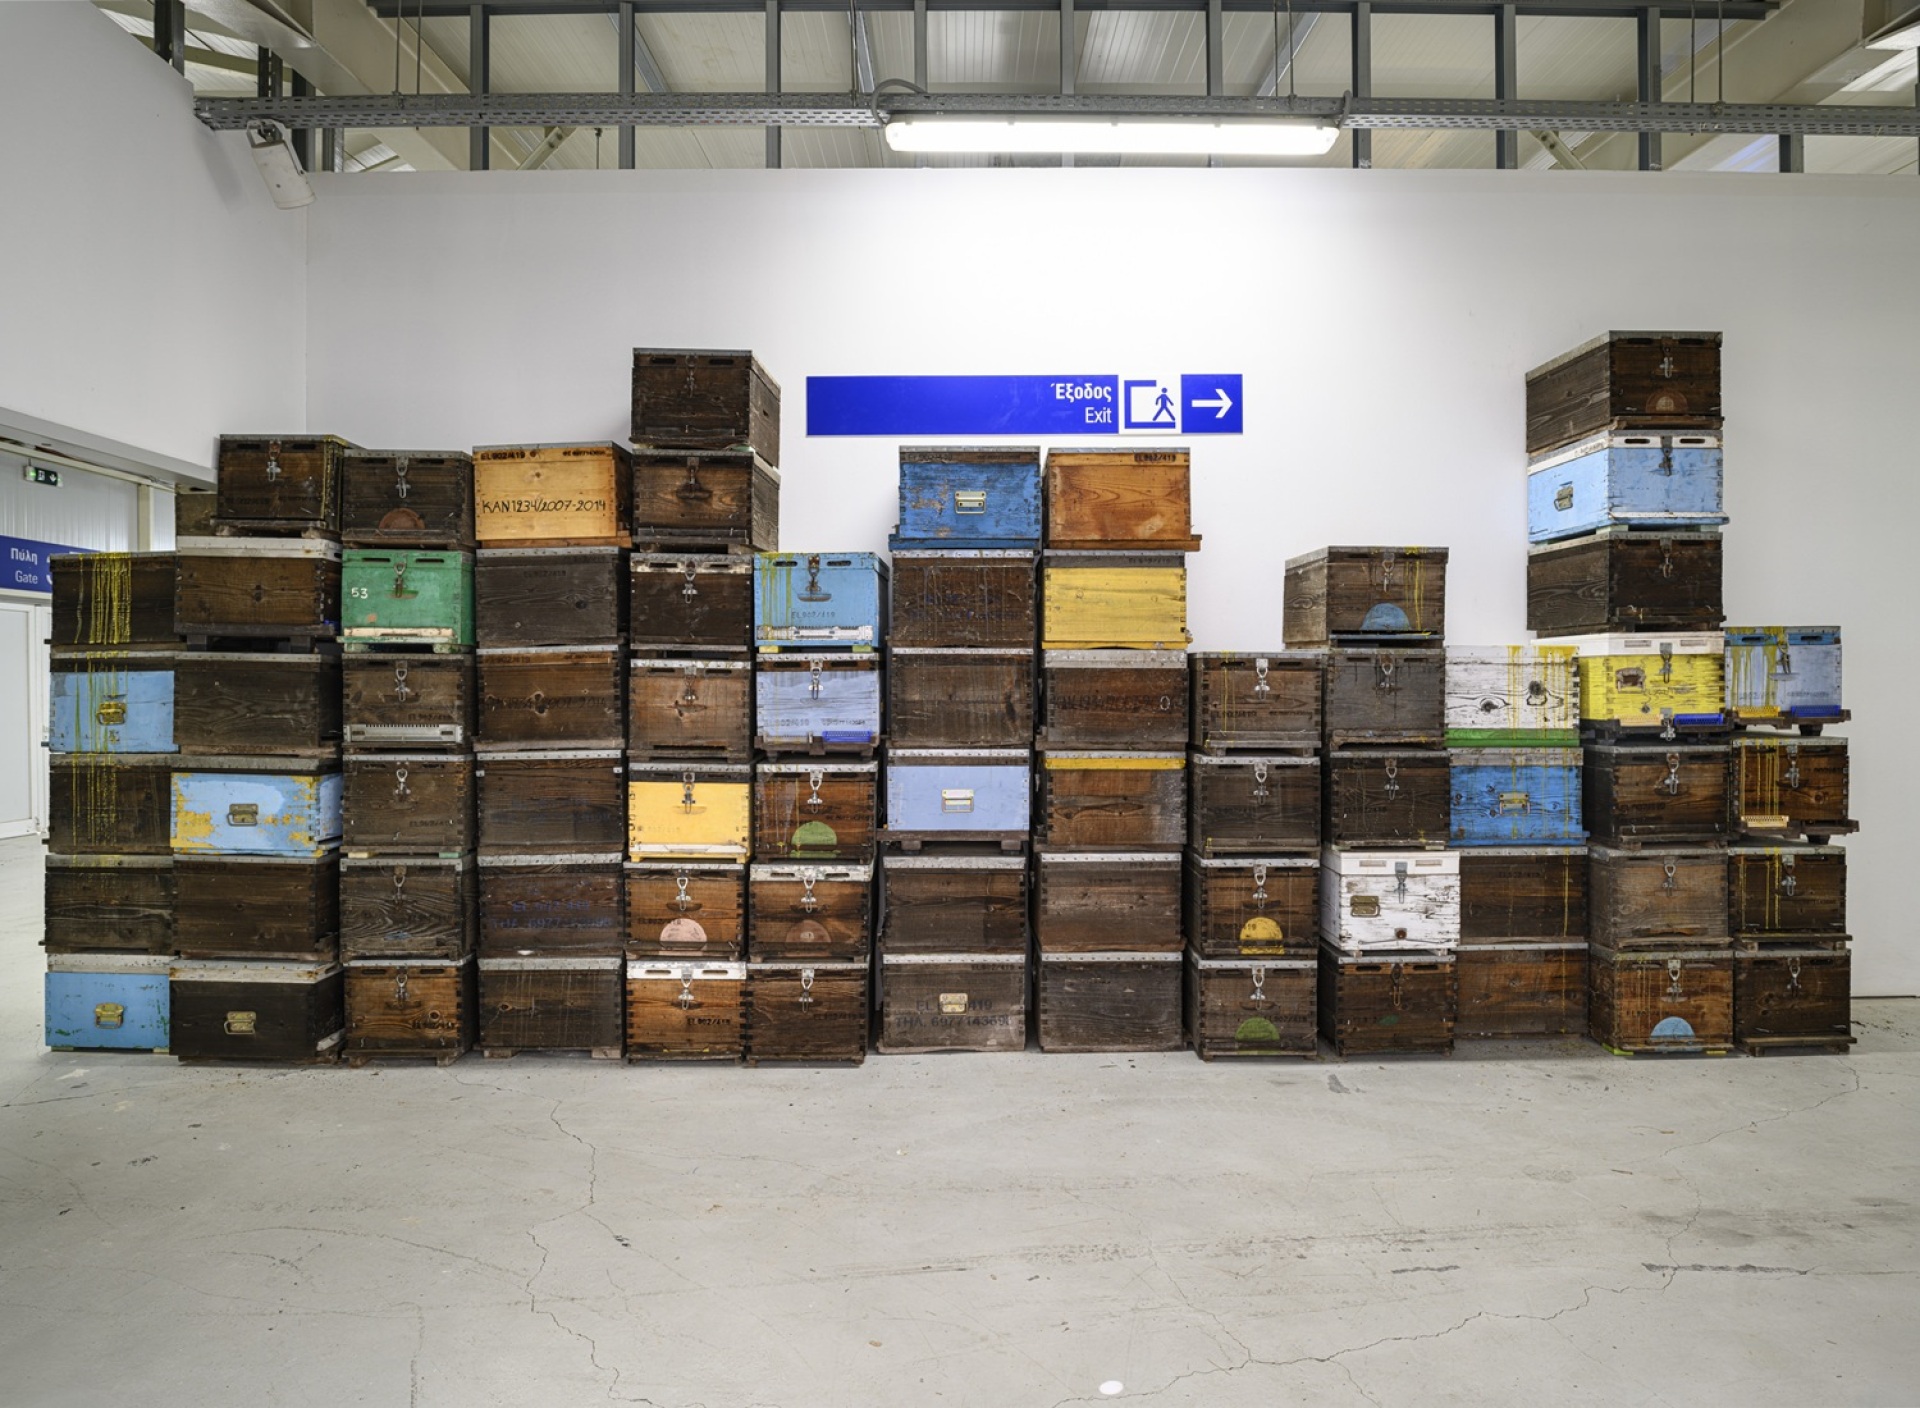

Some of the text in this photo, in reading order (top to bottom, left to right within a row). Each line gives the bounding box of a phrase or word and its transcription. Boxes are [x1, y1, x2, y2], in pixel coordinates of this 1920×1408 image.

[1050, 383, 1112, 403] Έξοδος
[1085, 407, 1112, 423] Exit
[10, 547, 38, 566] Πύλη
[15, 570, 38, 584] Gate
[351, 587, 368, 600] 53
